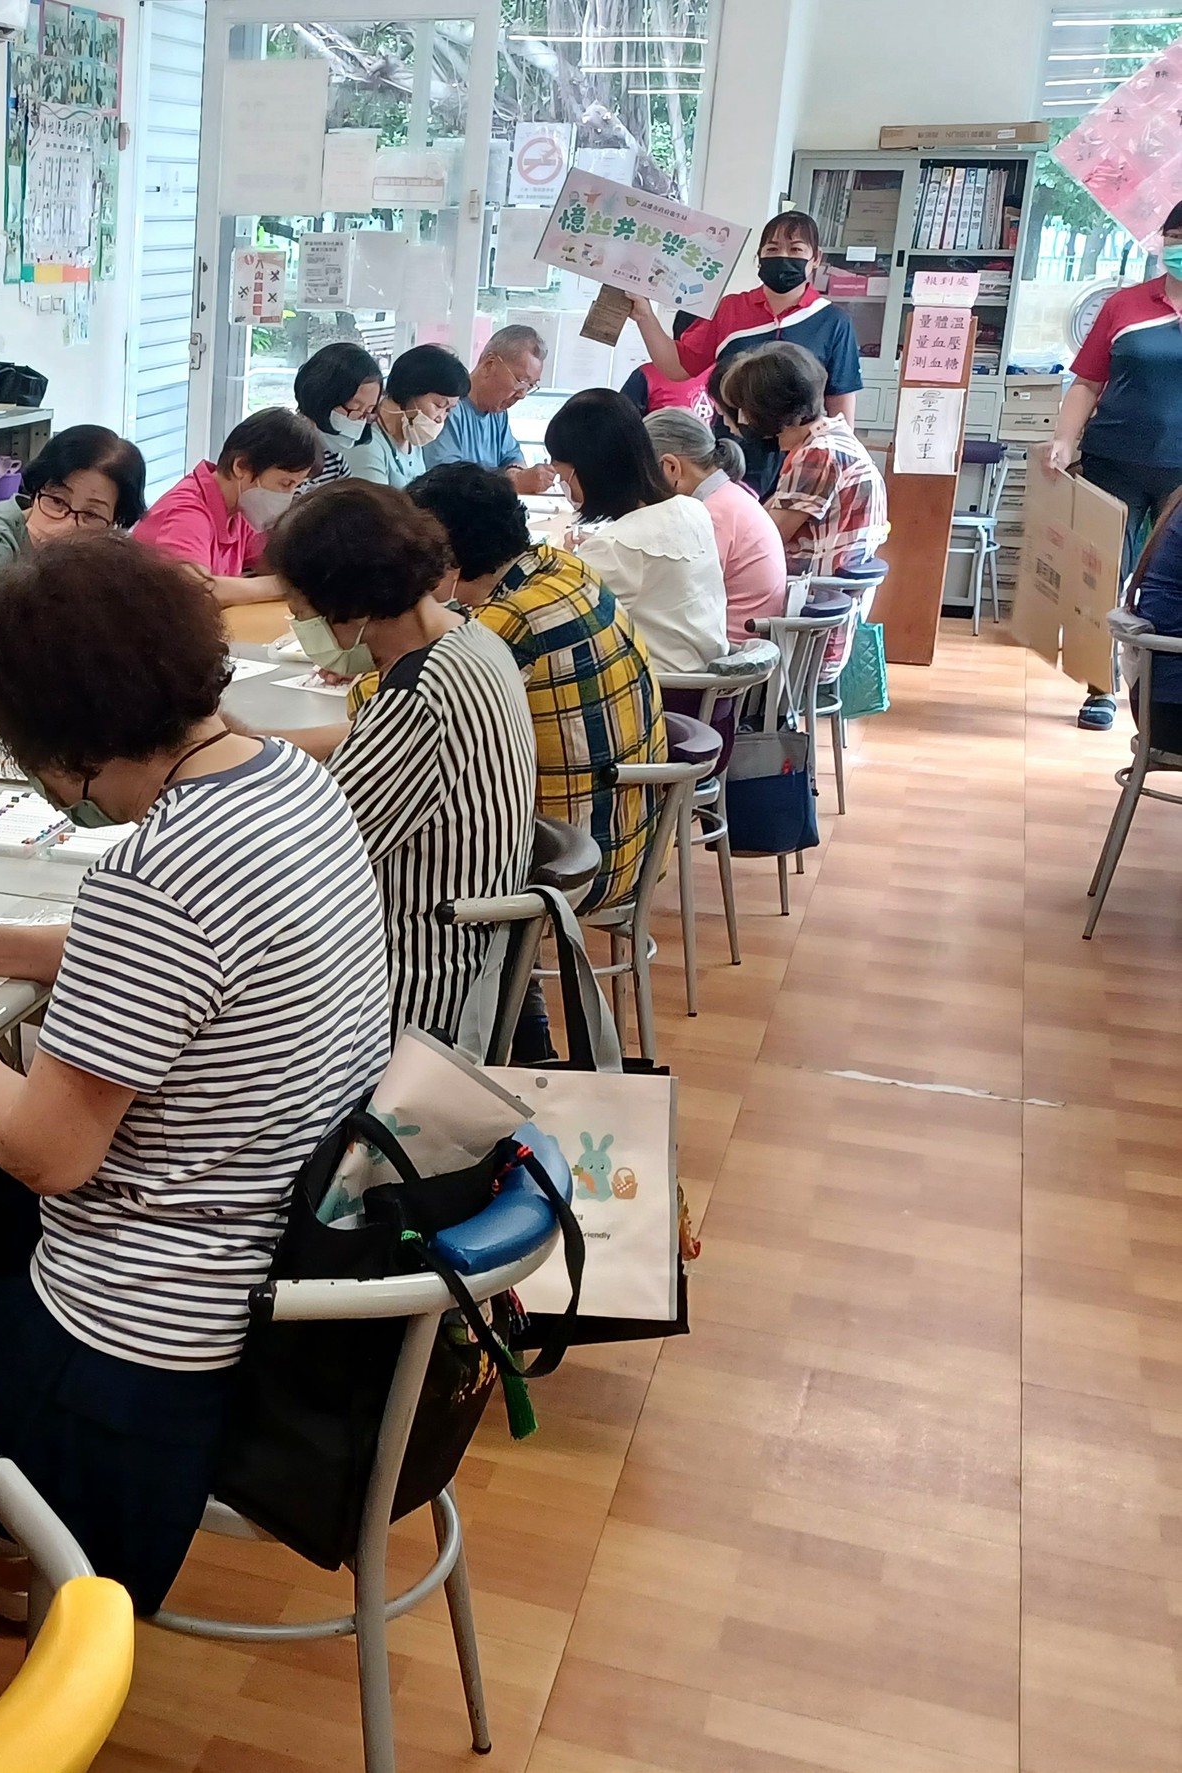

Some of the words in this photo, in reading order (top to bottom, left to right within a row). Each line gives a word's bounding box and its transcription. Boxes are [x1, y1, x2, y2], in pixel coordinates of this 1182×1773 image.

[558, 203, 724, 281] 憶起共好樂生活
[923, 276, 969, 287] 報到處
[919, 314, 965, 330] 量體溫
[916, 335, 962, 350] 量血壓
[911, 356, 959, 370] 測血糖
[911, 390, 945, 459] 量體重
[583, 1232, 610, 1240] riendly
